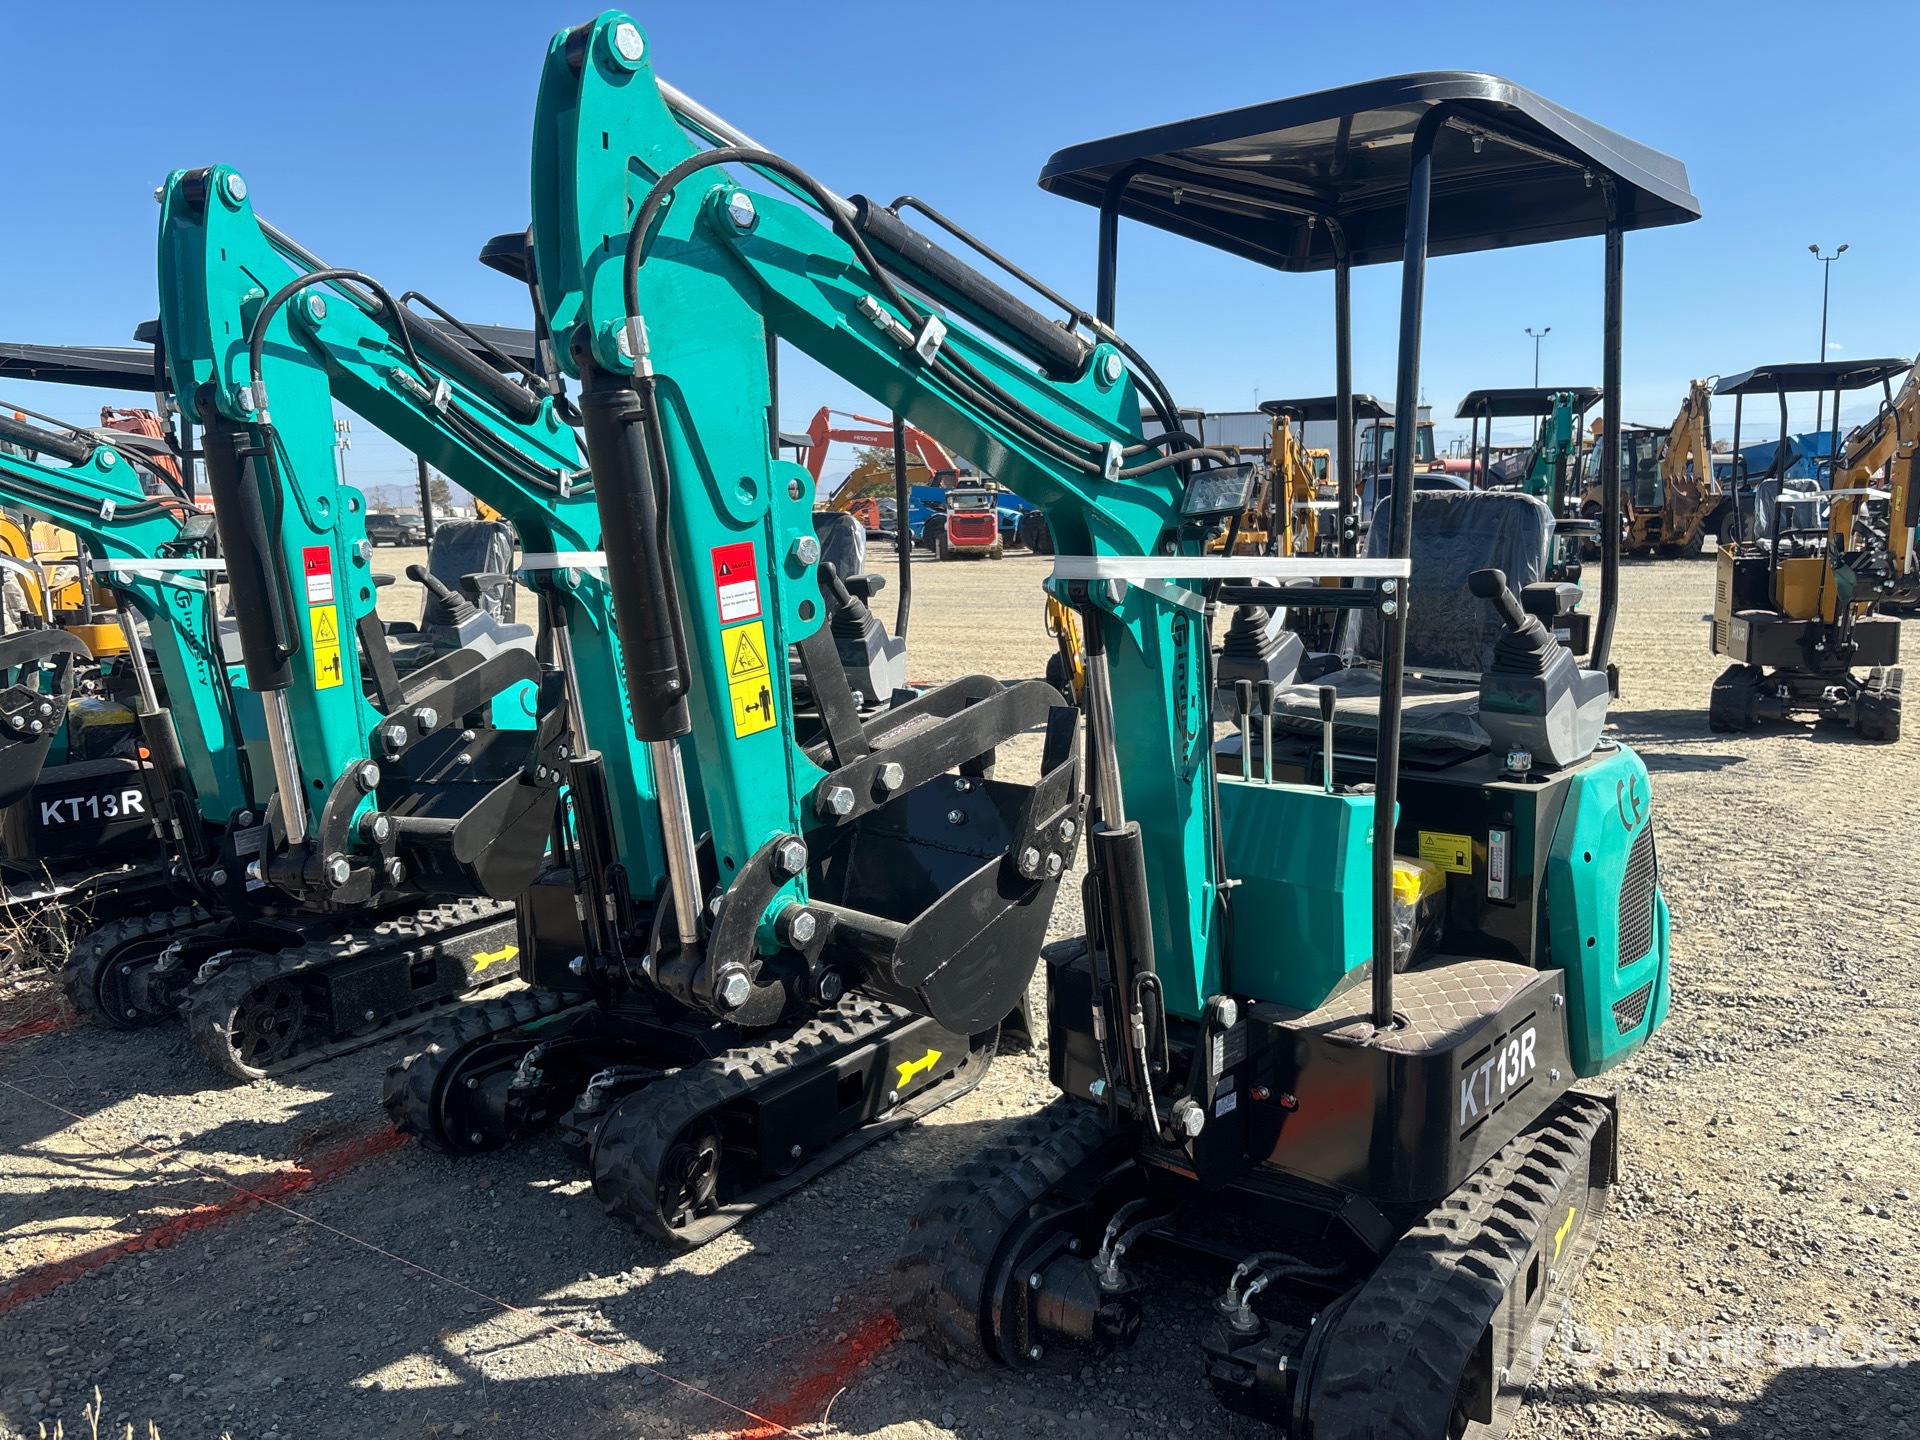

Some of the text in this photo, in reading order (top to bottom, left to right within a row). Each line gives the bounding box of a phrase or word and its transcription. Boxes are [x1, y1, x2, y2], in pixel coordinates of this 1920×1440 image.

[731, 560, 751, 569] DANGER
[41, 790, 146, 826] KT13R
[1460, 1027, 1537, 1126] KT13R
